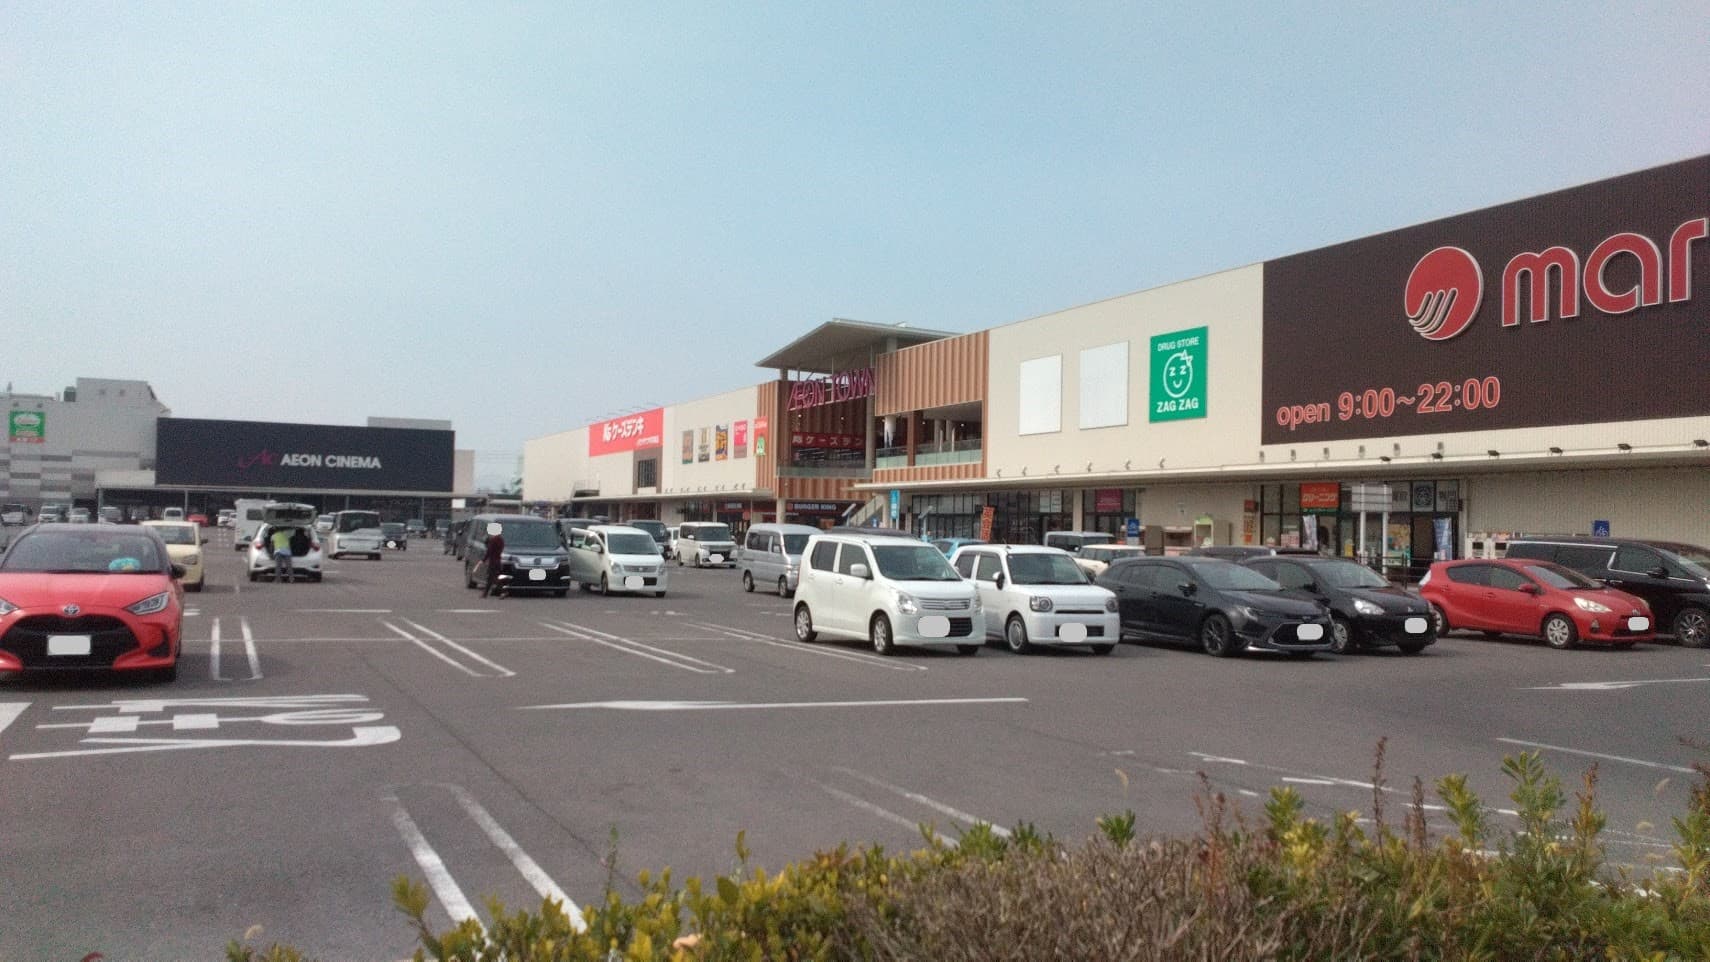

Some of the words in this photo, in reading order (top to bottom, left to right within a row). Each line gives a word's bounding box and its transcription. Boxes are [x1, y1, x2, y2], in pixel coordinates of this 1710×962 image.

[1157, 342, 1176, 351] DRUG
[1177, 337, 1199, 347] STORE
[1156, 401, 1176, 413] ZAG
[1178, 398, 1199, 411] ZAG
[1276, 402, 1331, 431] open
[280, 454, 321, 466] AEON
[325, 455, 382, 468] CINEMA
